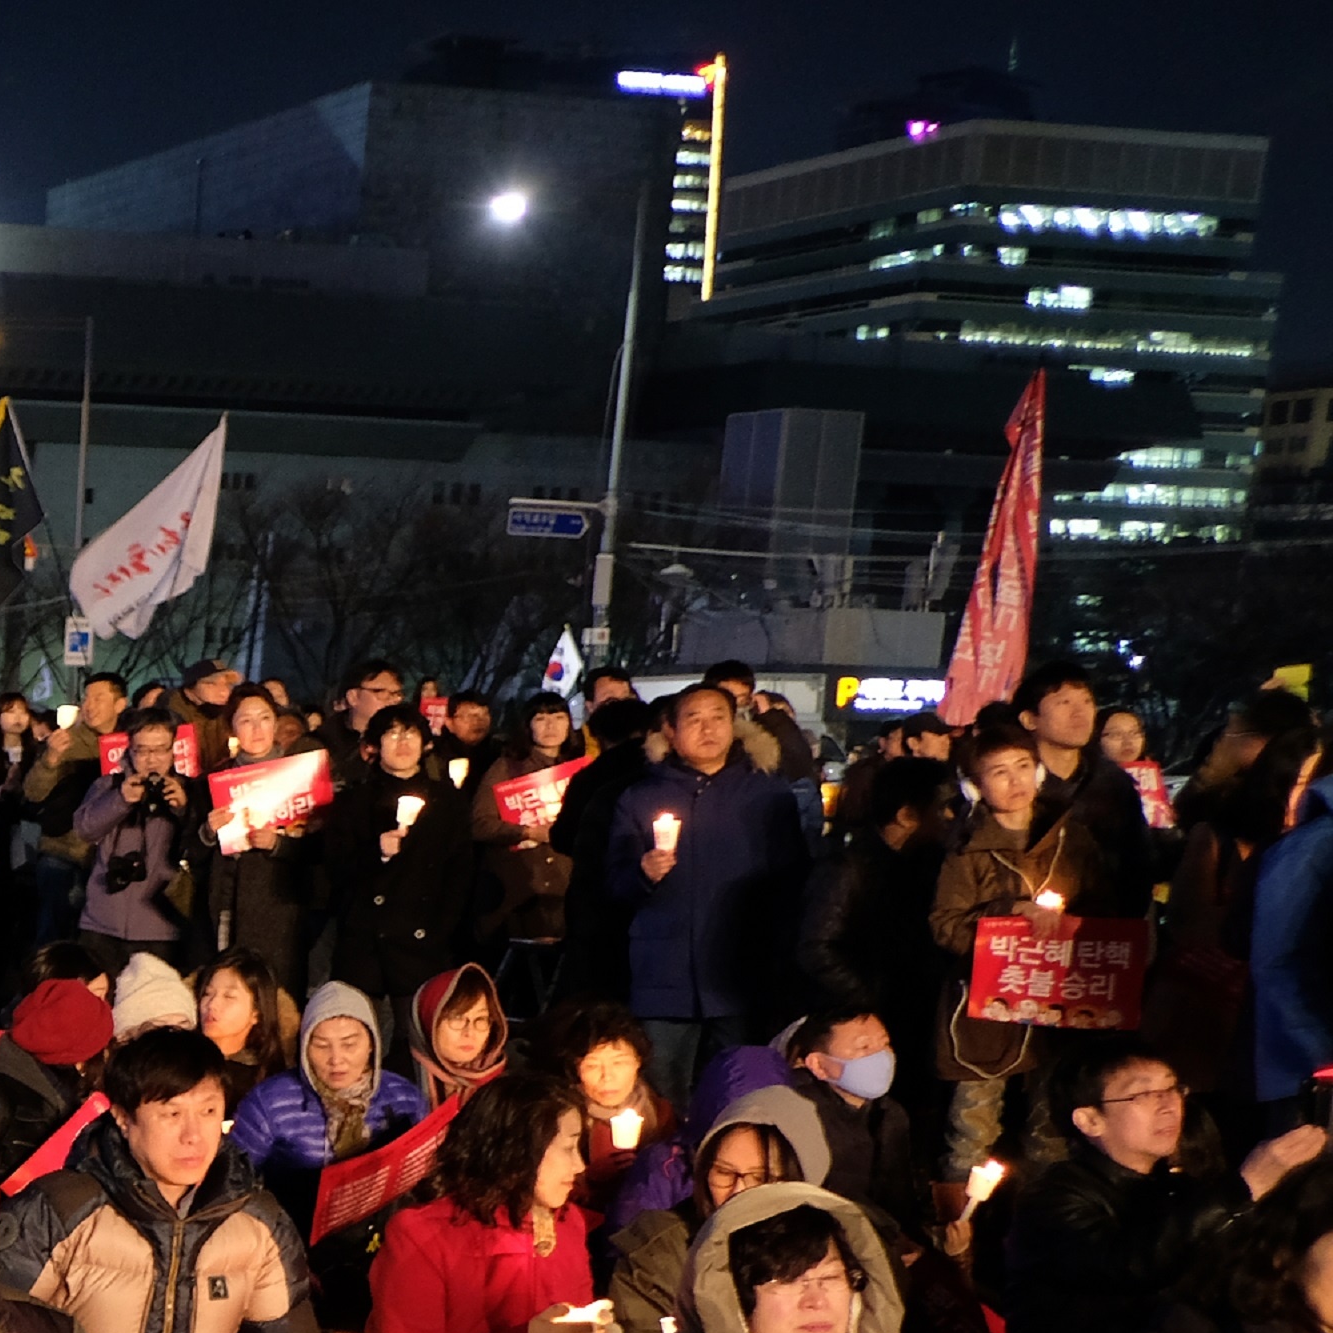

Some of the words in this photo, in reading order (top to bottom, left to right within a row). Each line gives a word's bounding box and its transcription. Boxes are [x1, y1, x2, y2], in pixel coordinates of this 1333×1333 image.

[836, 677, 860, 708] P
[989, 934, 1074, 968] 박근혜
[1077, 940, 1131, 969] 탄핵
[998, 964, 1054, 998] 촛불
[1059, 971, 1117, 1001] 승리
